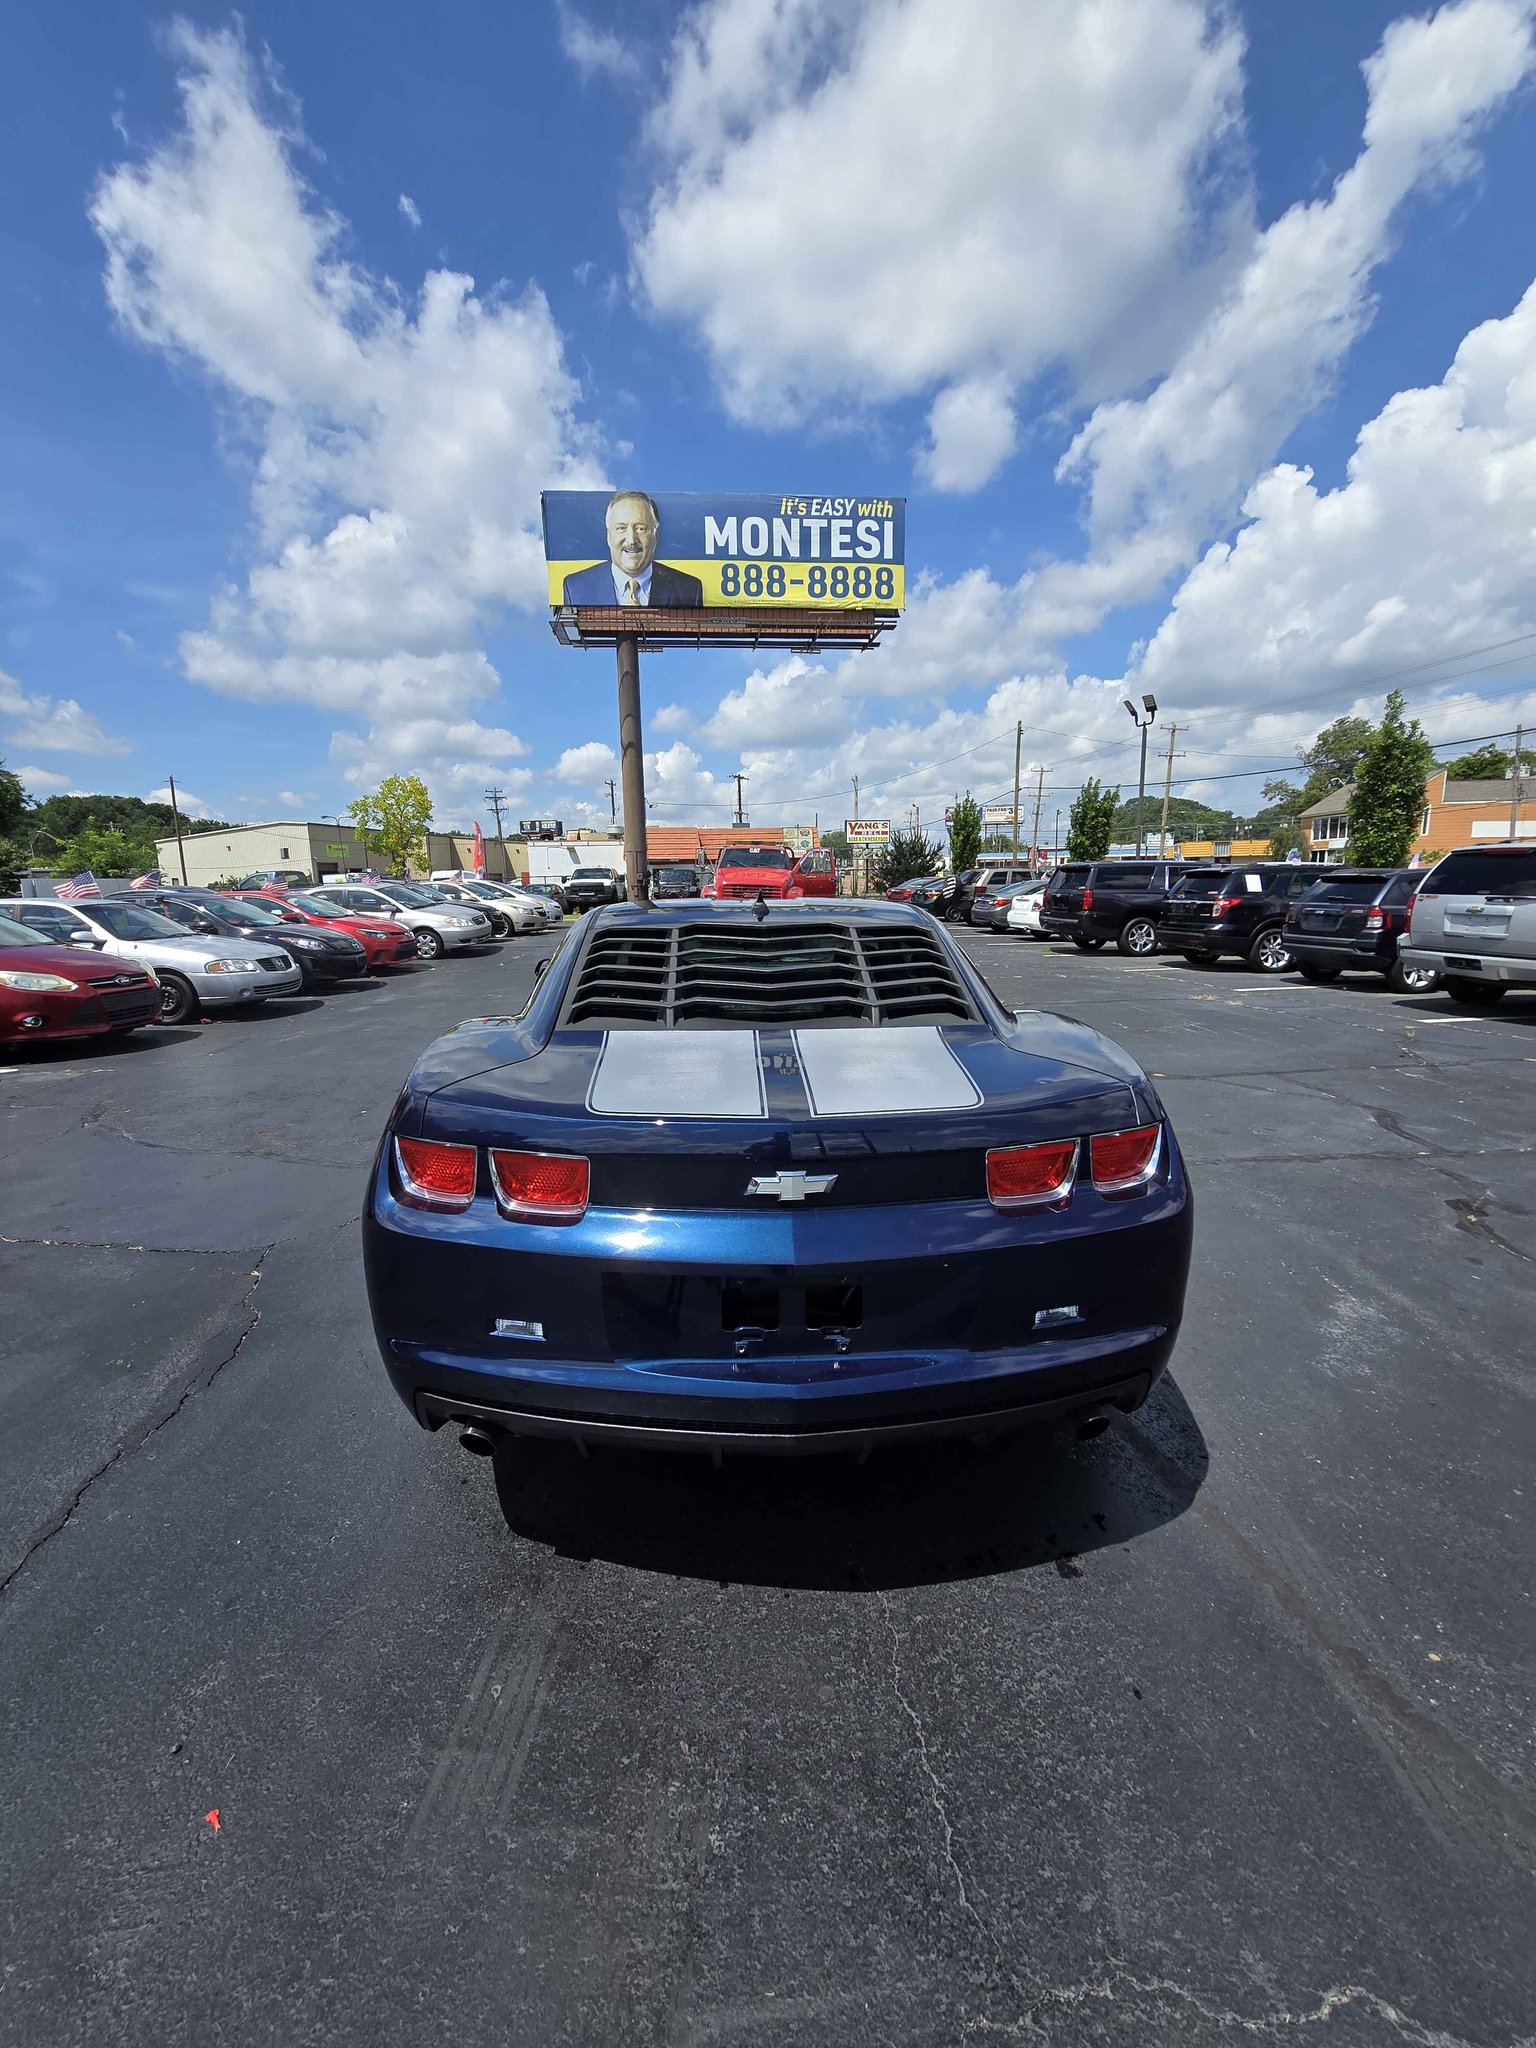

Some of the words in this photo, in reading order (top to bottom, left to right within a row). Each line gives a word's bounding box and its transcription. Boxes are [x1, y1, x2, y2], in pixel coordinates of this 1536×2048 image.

[780, 498, 807, 515] It's
[811, 499, 856, 516] EASY
[858, 500, 894, 518] with
[704, 516, 894, 559] MONTESI
[721, 563, 895, 599] 888-8888
[848, 822, 888, 834] YANG'S
